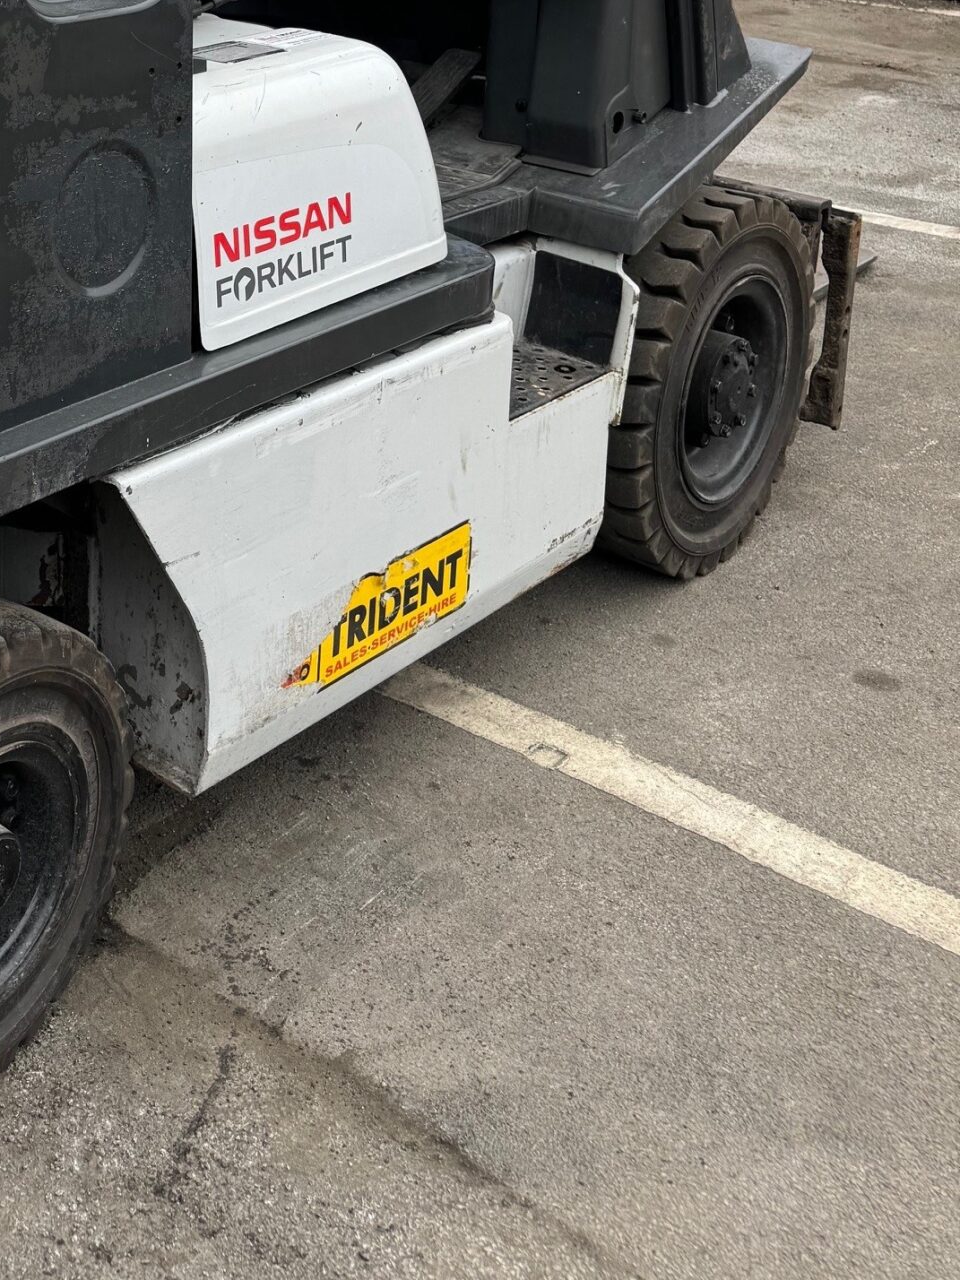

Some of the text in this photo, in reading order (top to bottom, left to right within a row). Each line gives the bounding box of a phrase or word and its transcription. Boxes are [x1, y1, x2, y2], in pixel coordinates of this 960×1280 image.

[213, 191, 352, 268] NISSAN
[215, 234, 352, 308] FORKLIFT
[332, 548, 464, 658] TRIDENT
